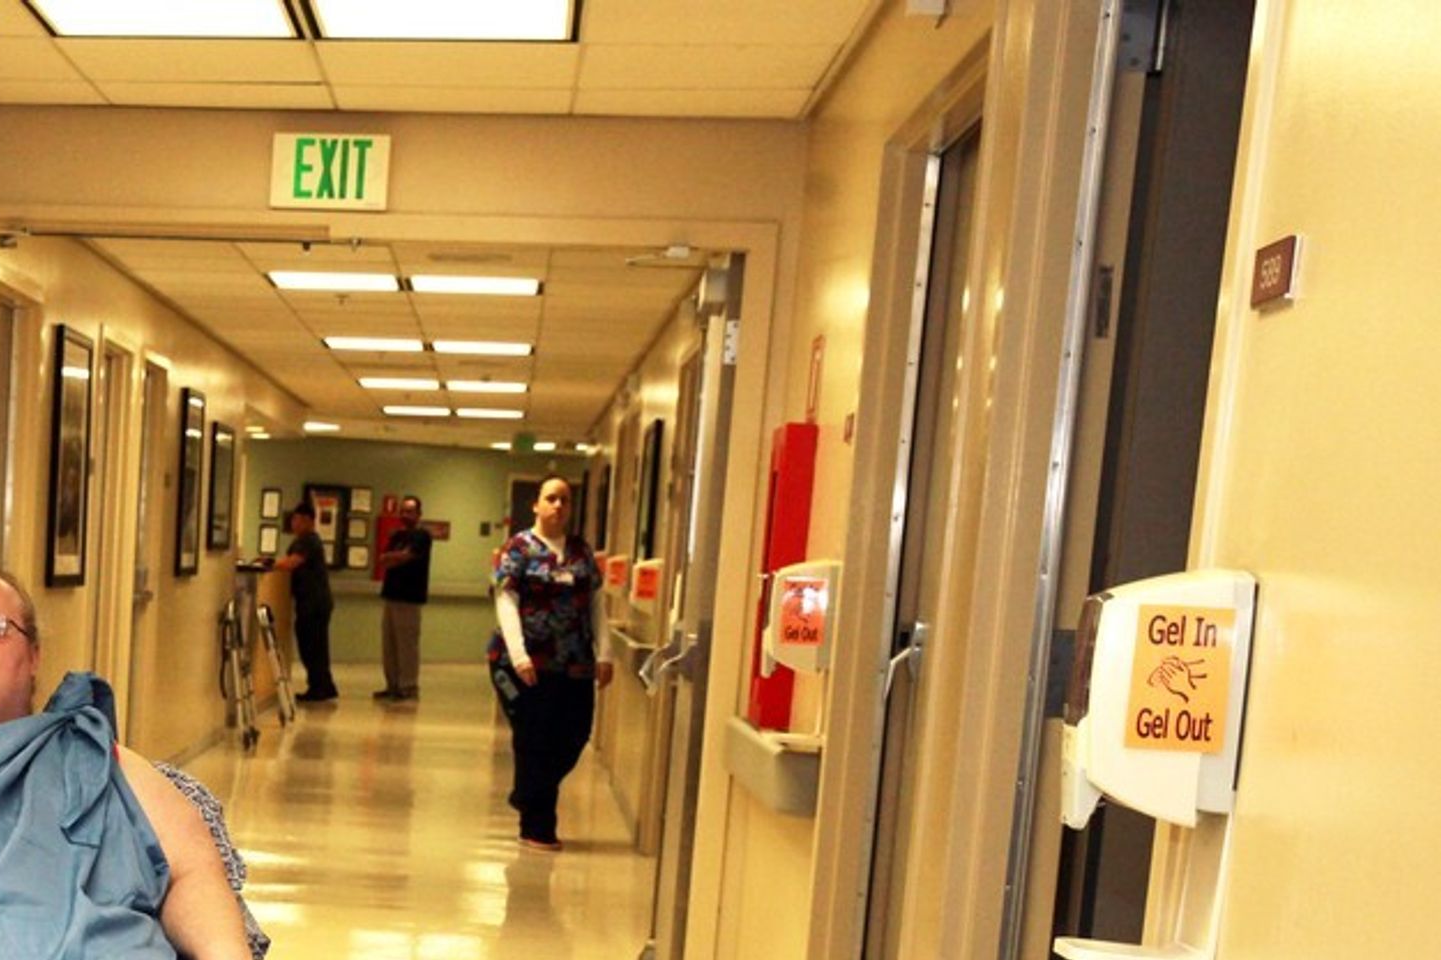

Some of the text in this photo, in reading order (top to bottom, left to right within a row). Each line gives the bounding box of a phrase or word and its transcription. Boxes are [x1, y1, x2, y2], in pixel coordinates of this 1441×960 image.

[292, 137, 374, 200] EXIT
[1148, 614, 1217, 648] Gel In
[1136, 707, 1213, 742] Gel Out
